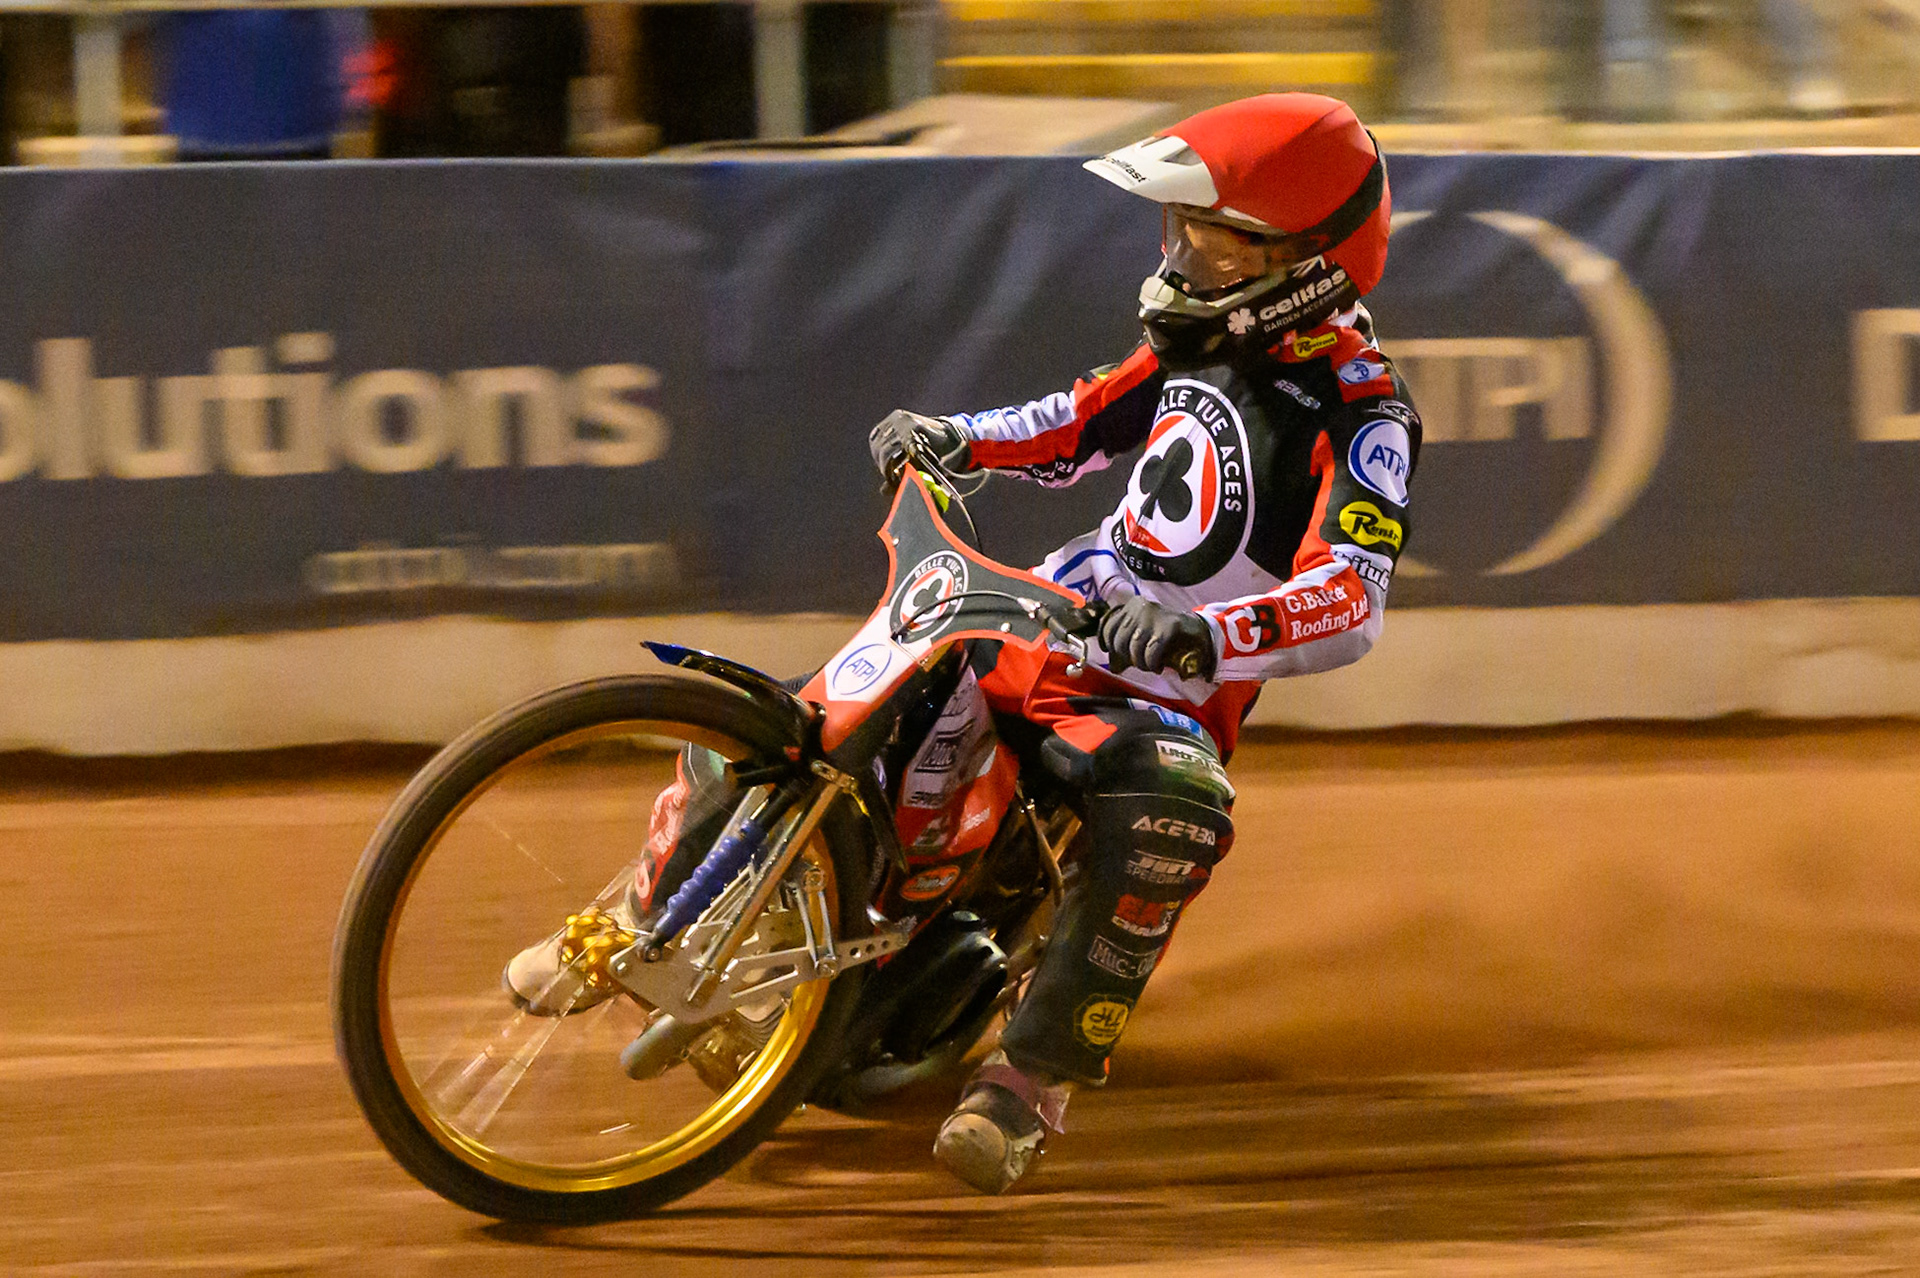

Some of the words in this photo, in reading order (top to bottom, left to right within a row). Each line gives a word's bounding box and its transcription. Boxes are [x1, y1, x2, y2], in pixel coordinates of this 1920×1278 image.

[1258, 268, 1347, 321] cellfas
[1263, 310, 1301, 333] GARDEN
[1195, 396, 1229, 437] VUE
[1219, 445, 1242, 513] ACES
[914, 556, 945, 579] BELLE
[946, 557, 962, 575] VUE
[1285, 584, 1348, 613] G.Baker
[1225, 604, 1281, 653] GB
[1290, 609, 1351, 641] Roofing
[846, 657, 879, 682] ATPI
